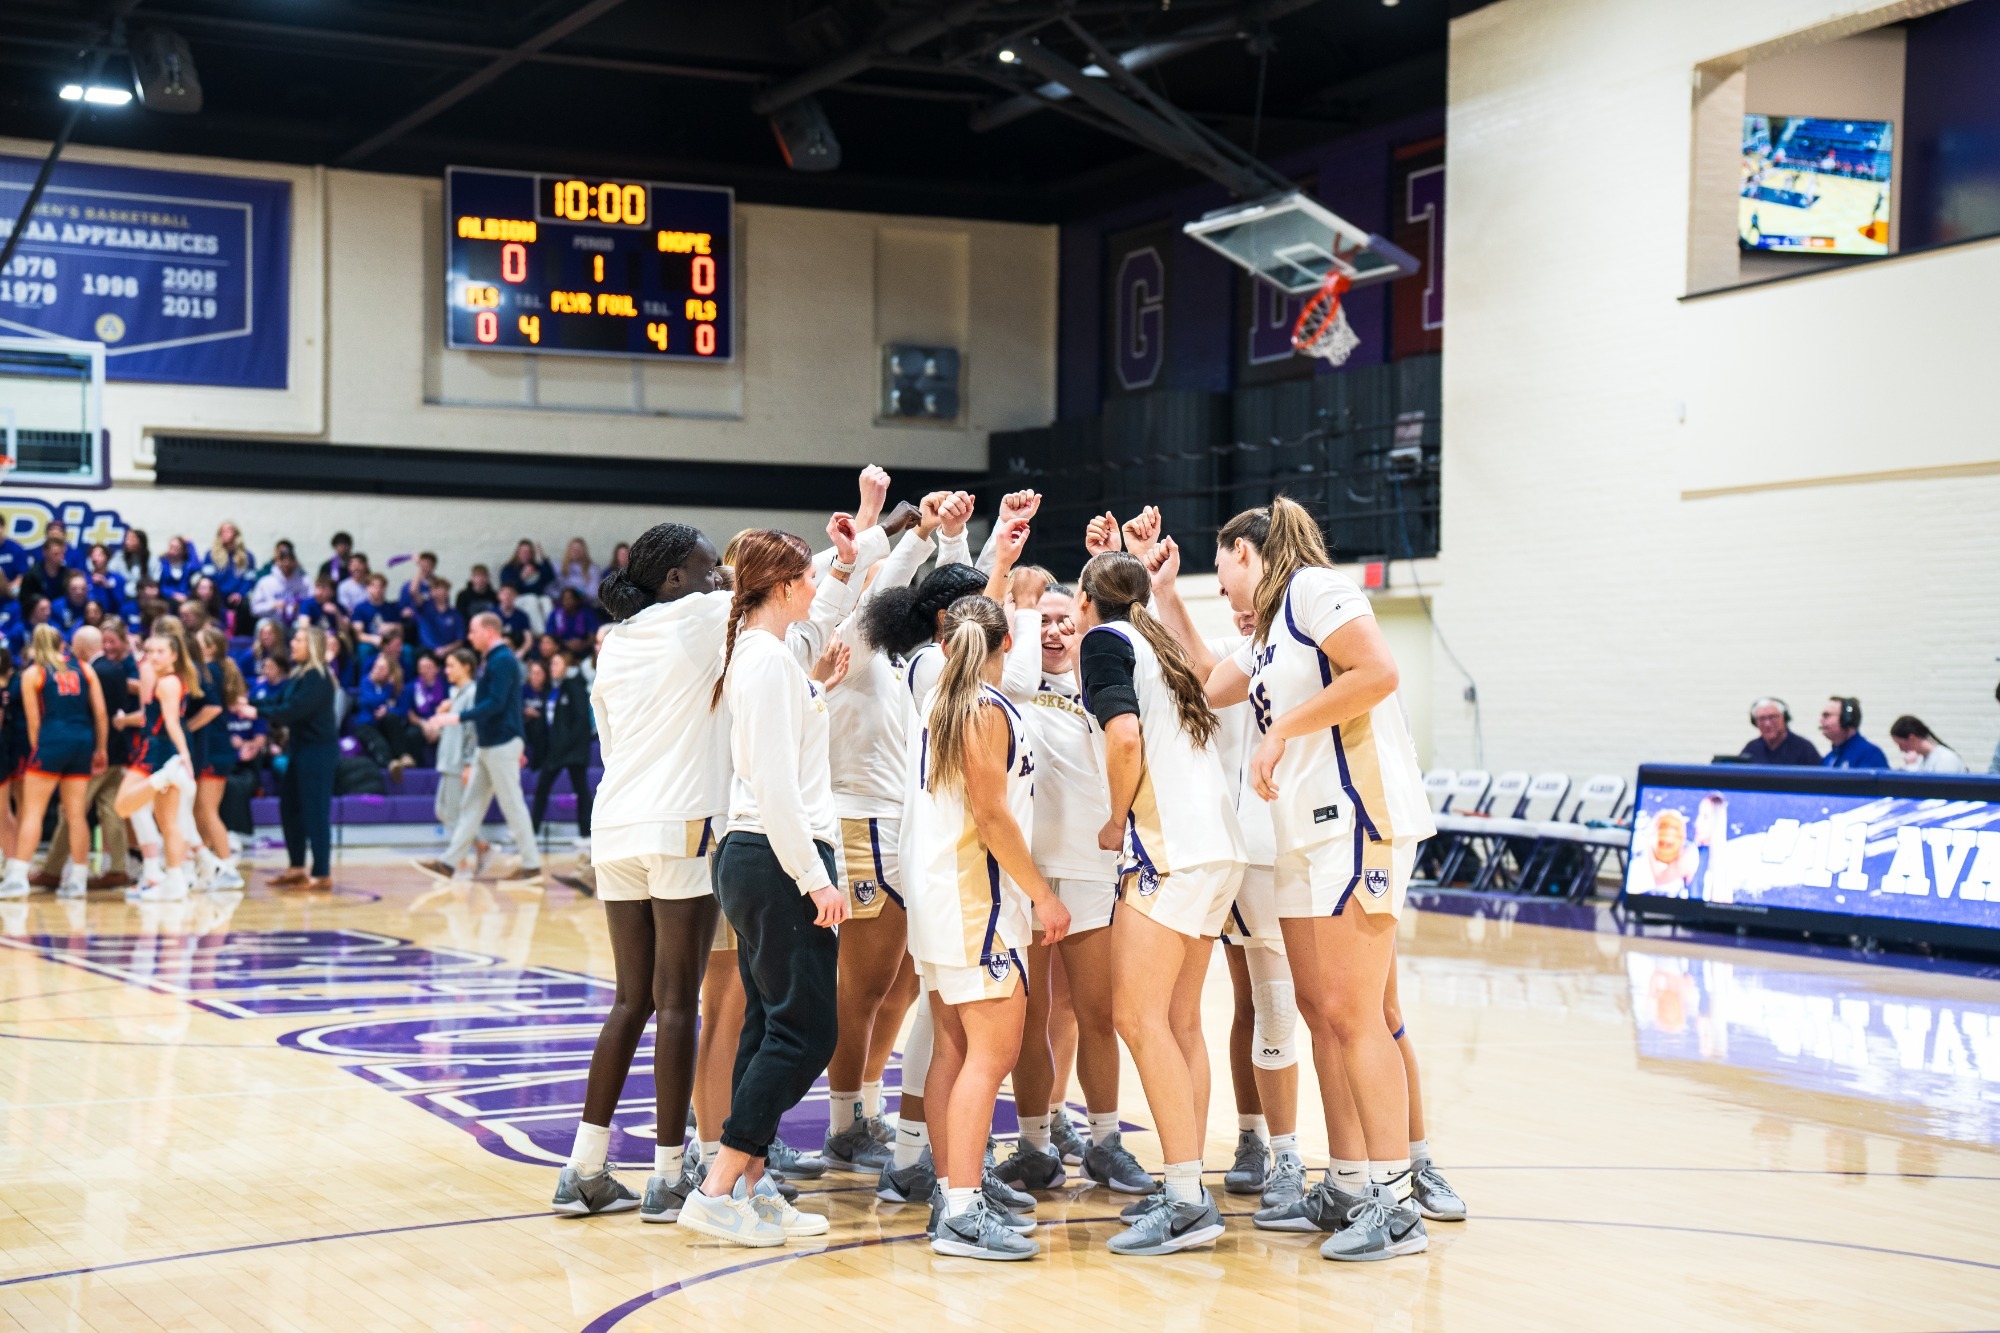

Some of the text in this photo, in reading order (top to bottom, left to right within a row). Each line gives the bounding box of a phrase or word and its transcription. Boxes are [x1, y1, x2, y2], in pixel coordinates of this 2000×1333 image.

[554, 180, 646, 225] 10:00
[84, 208, 191, 230] BASKETBALL
[458, 216, 537, 243] ALBION
[0, 217, 219, 255] NAA APPEARANCES
[657, 230, 712, 255] HOPE
[501, 242, 527, 283] 0
[593, 253, 605, 283] 1
[691, 255, 716, 295] 0
[0, 279, 58, 306] 1979
[81, 272, 140, 299] 1998
[160, 294, 218, 320] 2019
[596, 292, 639, 318] FOUL
[475, 311, 498, 344] 0
[518, 314, 541, 345] 4
[646, 322, 668, 352] 4
[695, 323, 716, 356] 0
